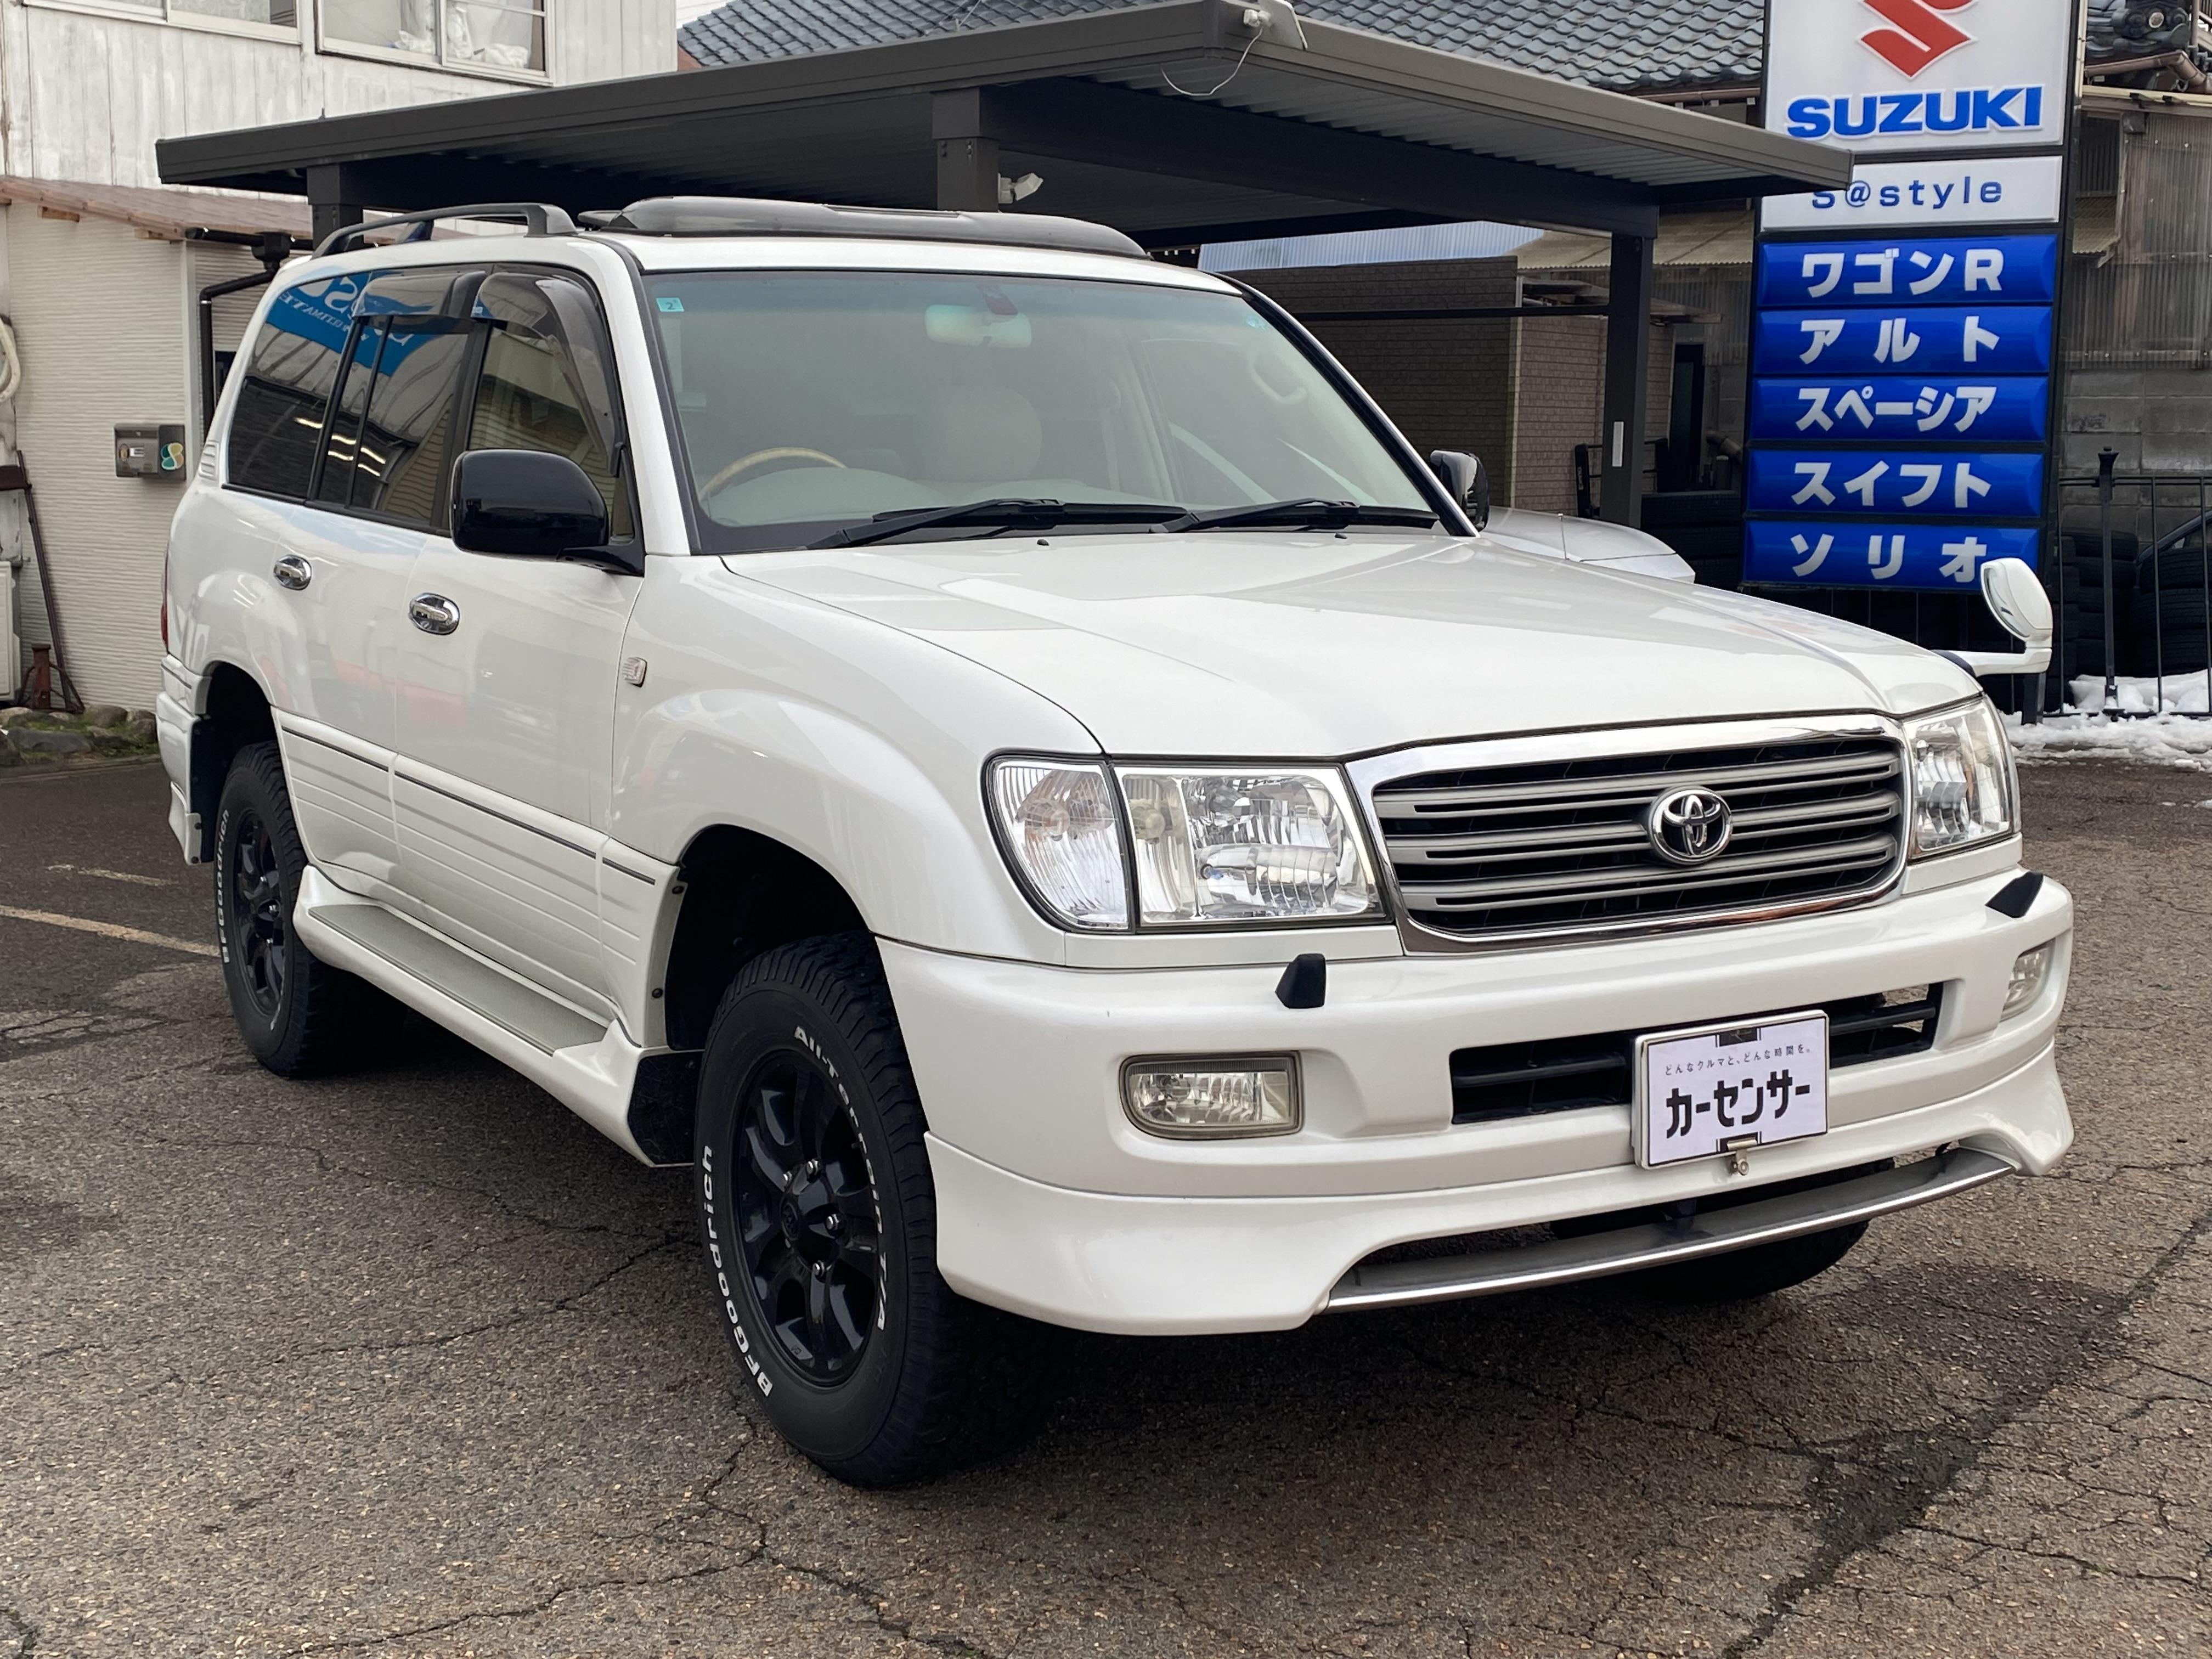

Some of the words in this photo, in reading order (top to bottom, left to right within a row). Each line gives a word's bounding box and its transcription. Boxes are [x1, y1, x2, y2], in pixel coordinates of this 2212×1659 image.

[1787, 86, 2044, 138] SUZUKI
[1802, 248, 2004, 298] ワゴンR
[1799, 315, 2000, 364] アルト
[1796, 385, 1997, 432] スペーシア
[1791, 460, 1991, 508] スイフト
[1790, 533, 1987, 583] ソリオ
[1665, 1044, 1810, 1075] どんなクルマと、どんな時間を。
[1666, 1069, 1810, 1139] カーセンサー
[702, 1146, 772, 1397] BFGoodrich
